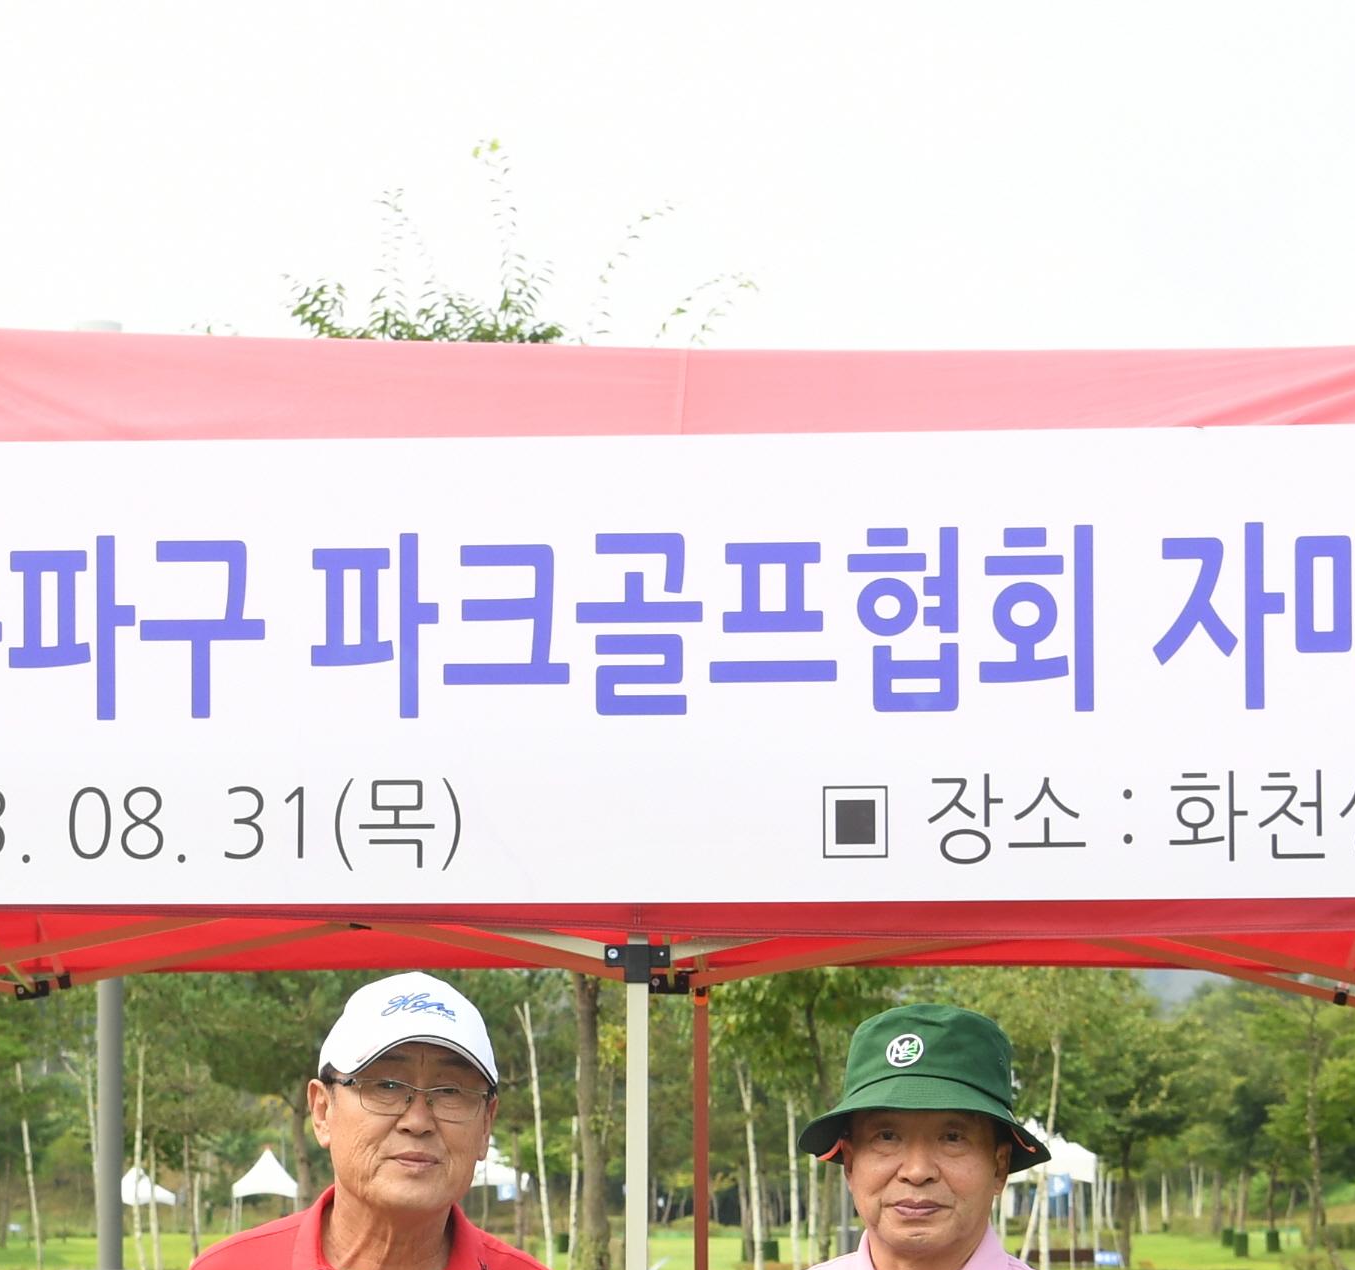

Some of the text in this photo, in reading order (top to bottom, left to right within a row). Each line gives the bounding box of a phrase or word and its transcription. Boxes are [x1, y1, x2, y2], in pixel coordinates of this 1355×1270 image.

[310, 523, 1095, 720] 파크골프협회
[68, 785, 186, 863] 08.
[223, 776, 461, 872] 31(목)
[926, 772, 1087, 865] 장소
